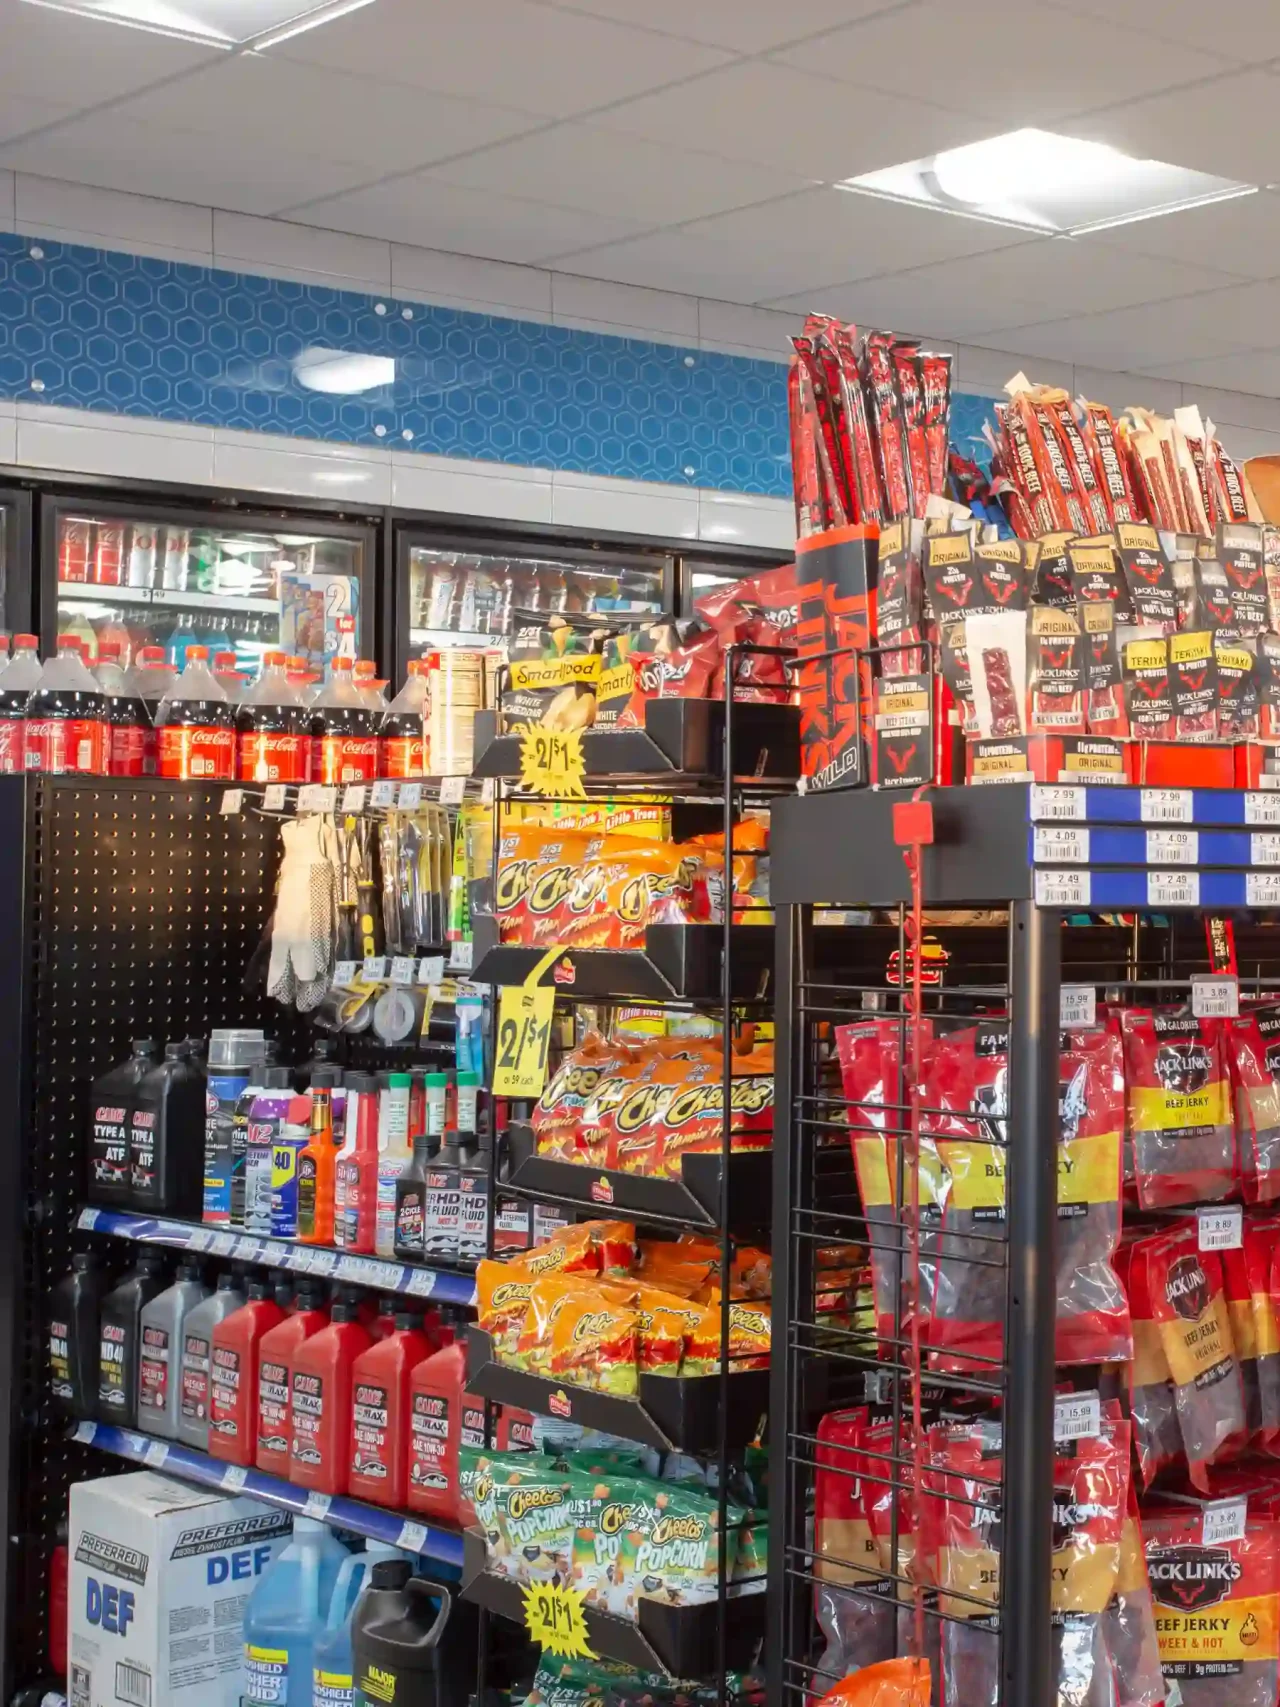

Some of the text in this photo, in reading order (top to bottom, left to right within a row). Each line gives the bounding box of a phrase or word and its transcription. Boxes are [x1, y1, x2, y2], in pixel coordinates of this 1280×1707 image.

[1123, 537, 1157, 549] ORIGINAL
[932, 551, 968, 563] ORIGINAL
[326, 583, 346, 617] 2
[812, 746, 857, 789] WILD
[1053, 790, 1075, 800] 2.99
[1160, 791, 1181, 801] 2.99
[1262, 796, 1280, 804] 2.99
[1055, 831, 1076, 841] 4.09
[1168, 834, 1188, 843] 4.09
[1058, 874, 1079, 884] 2.49
[1167, 875, 1187, 884] 2.49
[1167, 1019, 1198, 1031] CALORIES
[1259, 1022, 1270, 1032] 100
[497, 1016, 550, 1069] 2/$1
[1154, 1054, 1212, 1074] JACK LINK'S
[1165, 1097, 1209, 1109] BEEF JERKY
[1069, 1406, 1091, 1418] 15.99
[181, 1514, 281, 1544] PREFERRED
[81, 1534, 139, 1567] PREFERRED
[207, 1546, 272, 1585] DEF
[1148, 1561, 1241, 1580] ACK LINK'S
[87, 1577, 136, 1637] DEF
[1156, 1618, 1230, 1631] EEF JERKY
[1192, 1638, 1198, 1649] &
[1203, 1638, 1223, 1648] HOT
